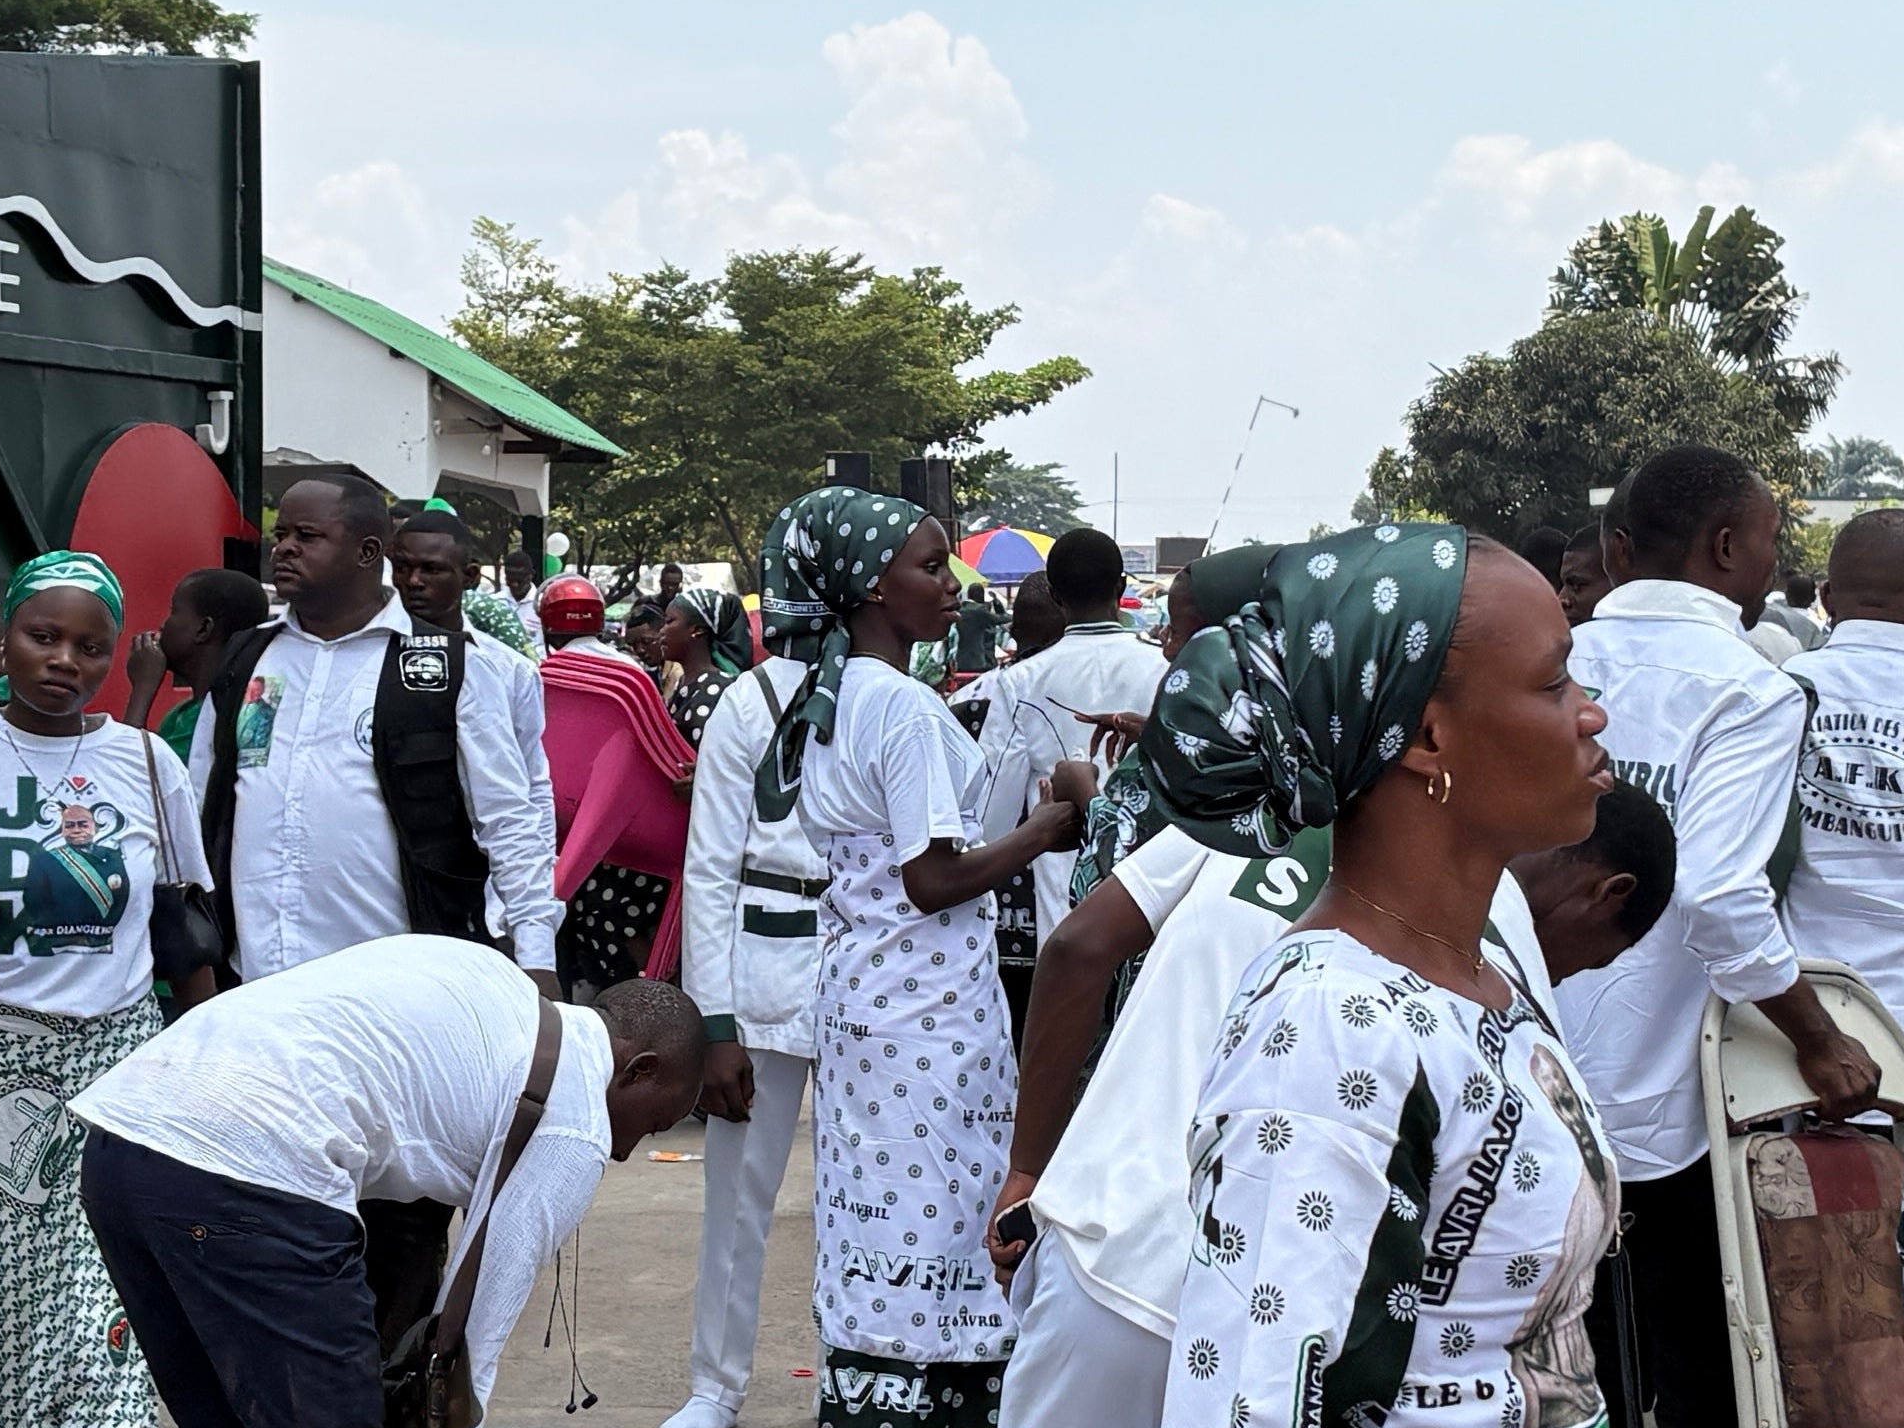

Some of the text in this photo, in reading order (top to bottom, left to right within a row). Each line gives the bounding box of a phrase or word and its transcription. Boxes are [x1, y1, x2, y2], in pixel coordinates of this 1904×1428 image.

[399, 635, 449, 648] PRESSE
[1872, 716, 1901, 739] DES
[848, 1202, 890, 1221] AVRIL
[841, 1246, 988, 1292] AVRIL
[1414, 1381, 1463, 1410] LE
